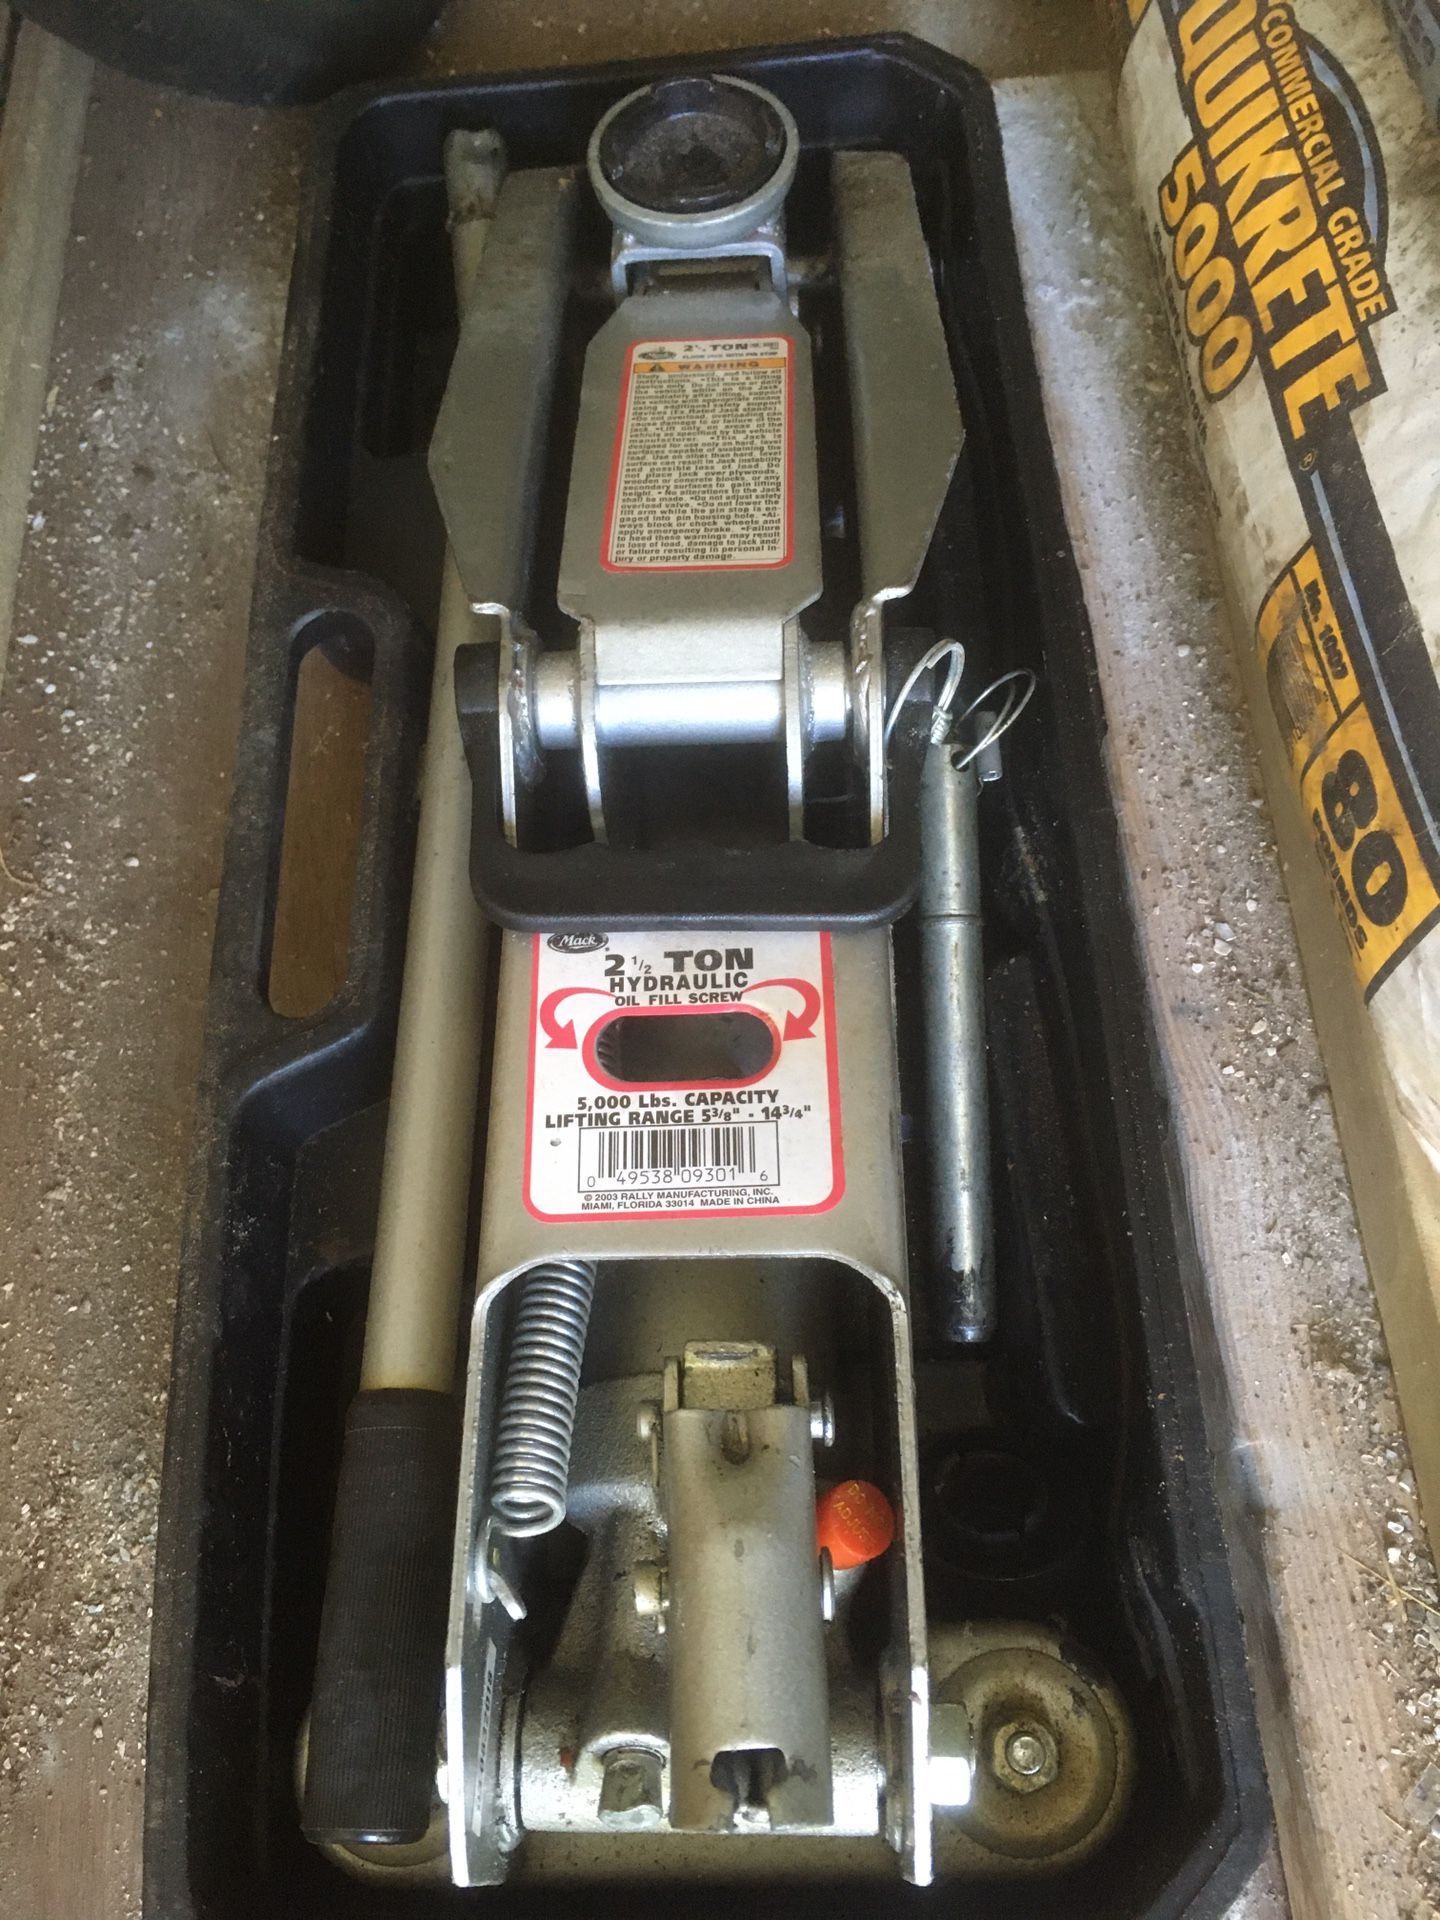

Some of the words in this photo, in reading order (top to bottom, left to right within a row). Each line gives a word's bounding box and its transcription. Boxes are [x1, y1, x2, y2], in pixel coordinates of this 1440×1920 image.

[1260, 9, 1346, 207] COMMERCIAL
[1327, 207, 1388, 323] GRADE
[1178, 0, 1371, 439] QUIKRETE
[1160, 145, 1254, 395] 5000
[678, 361, 759, 370] WARNING
[1321, 749, 1409, 927] 80
[559, 934, 598, 947] Mack
[604, 953, 625, 977] 2
[664, 948, 754, 973] TON
[609, 971, 749, 994] HYDRAULIC
[614, 994, 640, 1007] OIL
[648, 993, 682, 1006] FILL
[688, 991, 744, 1004] SCREW
[577, 1095, 631, 1111] 5,000
[638, 1094, 677, 1109] Lbs.
[684, 1089, 779, 1107] CAPACITY
[545, 1110, 624, 1129] LIFTING
[628, 1108, 694, 1126] RANGE
[586, 1176, 596, 1188] 0
[616, 1169, 673, 1185] 49538
[680, 1168, 736, 1184] 09301
[759, 1170, 768, 1182] 6
[594, 1193, 618, 1202] 2003
[620, 1191, 654, 1201] RALLY
[752, 1187, 774, 1196] INC.
[616, 1200, 662, 1210] FLORIDA
[665, 1199, 694, 1208] 33014
[700, 1198, 731, 1207] MADE
[733, 1197, 744, 1206] IN
[746, 1195, 780, 1205] CHINA
